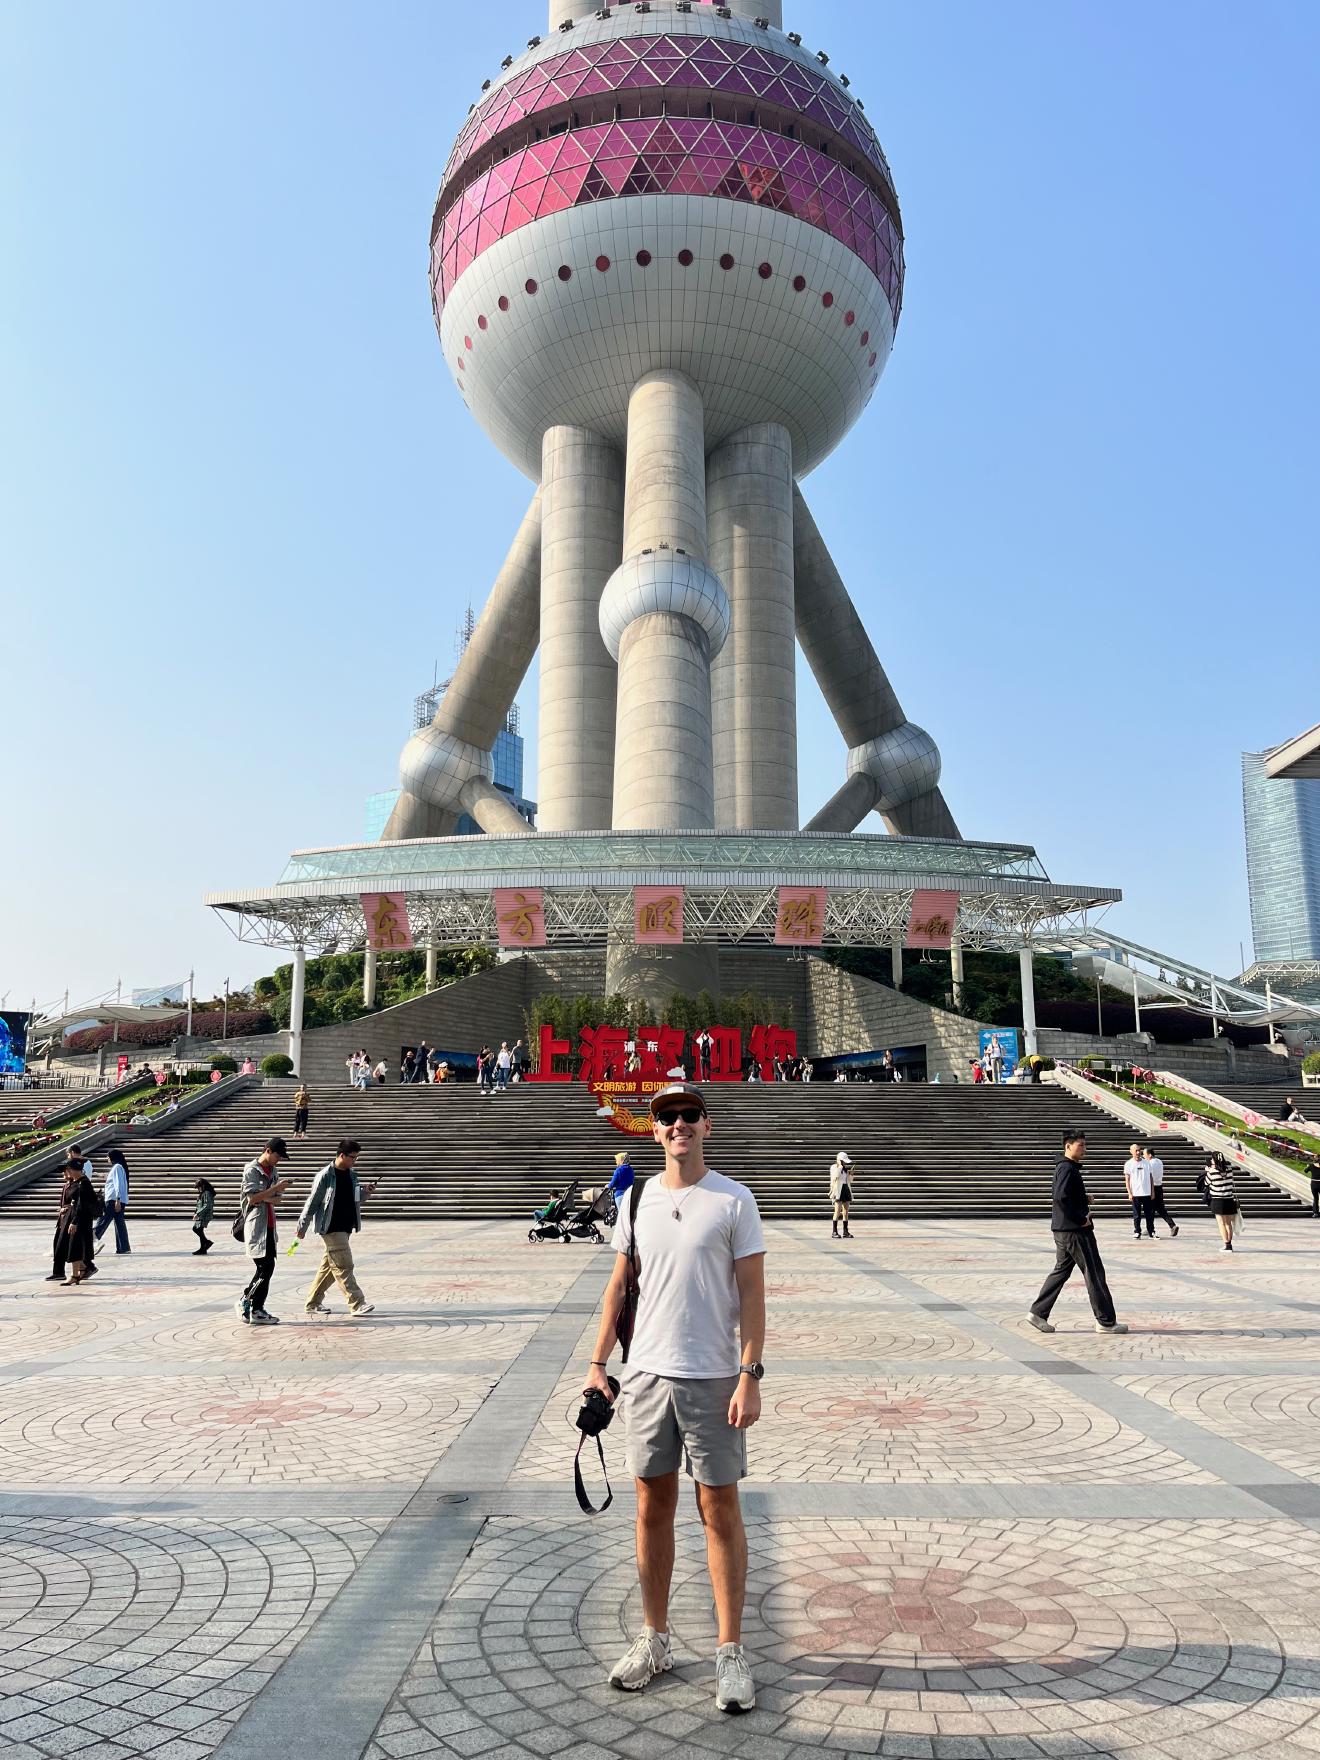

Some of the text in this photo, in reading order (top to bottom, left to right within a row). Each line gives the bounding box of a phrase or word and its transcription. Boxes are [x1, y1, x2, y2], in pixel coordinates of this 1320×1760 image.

[500, 893, 540, 941] 方
[779, 894, 824, 940] 珠
[592, 1081, 637, 1092] 文明旅游
